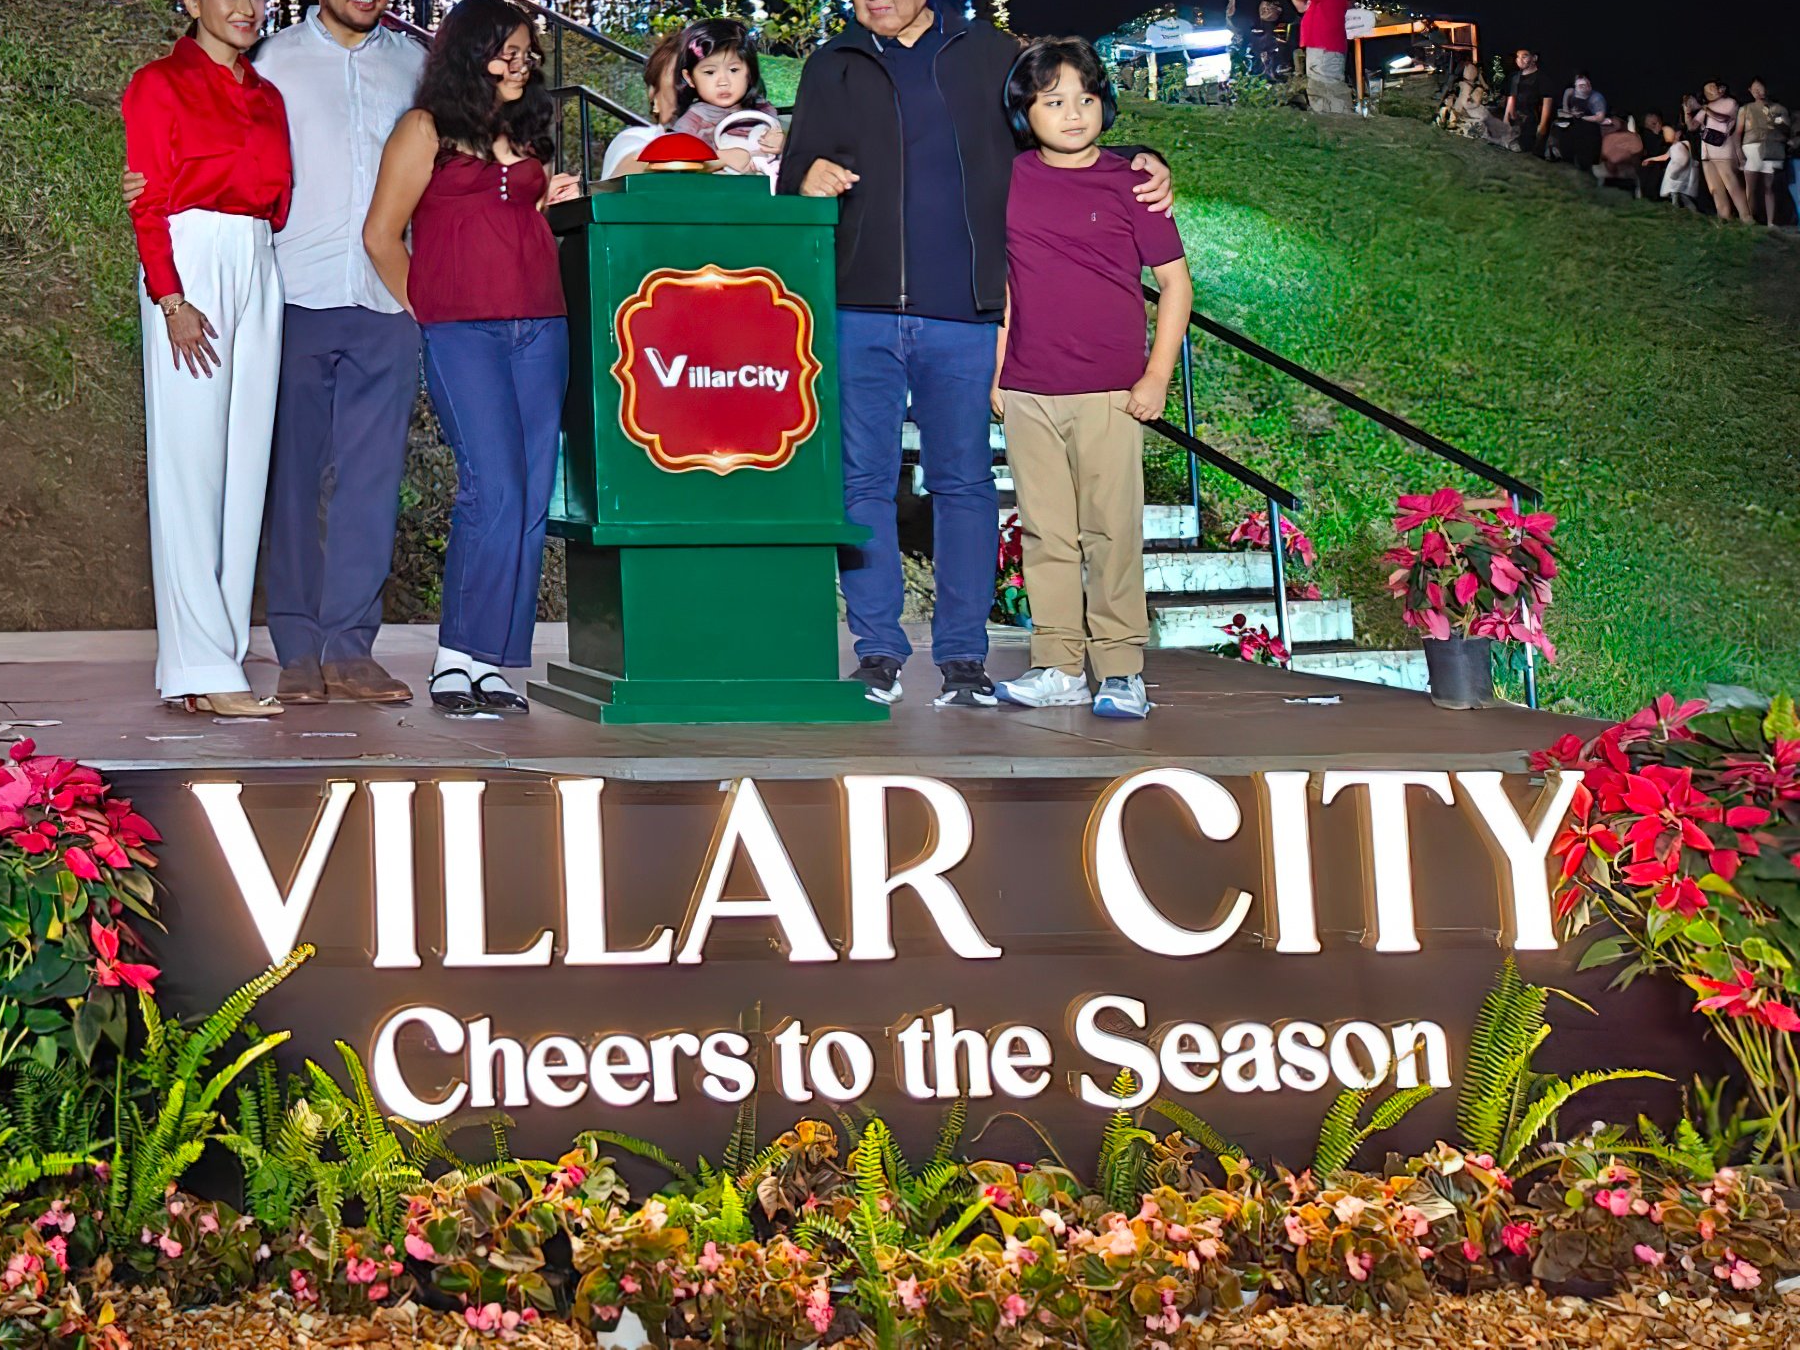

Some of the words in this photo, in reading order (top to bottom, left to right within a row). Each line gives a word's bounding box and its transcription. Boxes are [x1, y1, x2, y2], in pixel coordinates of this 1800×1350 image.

[190, 774, 1003, 969] VILLAR
[1094, 766, 1585, 956] CITY
[373, 1005, 757, 1123] Cheers
[774, 1019, 875, 1103] to
[897, 1006, 1053, 1100] the
[1074, 994, 1453, 1110] Season
